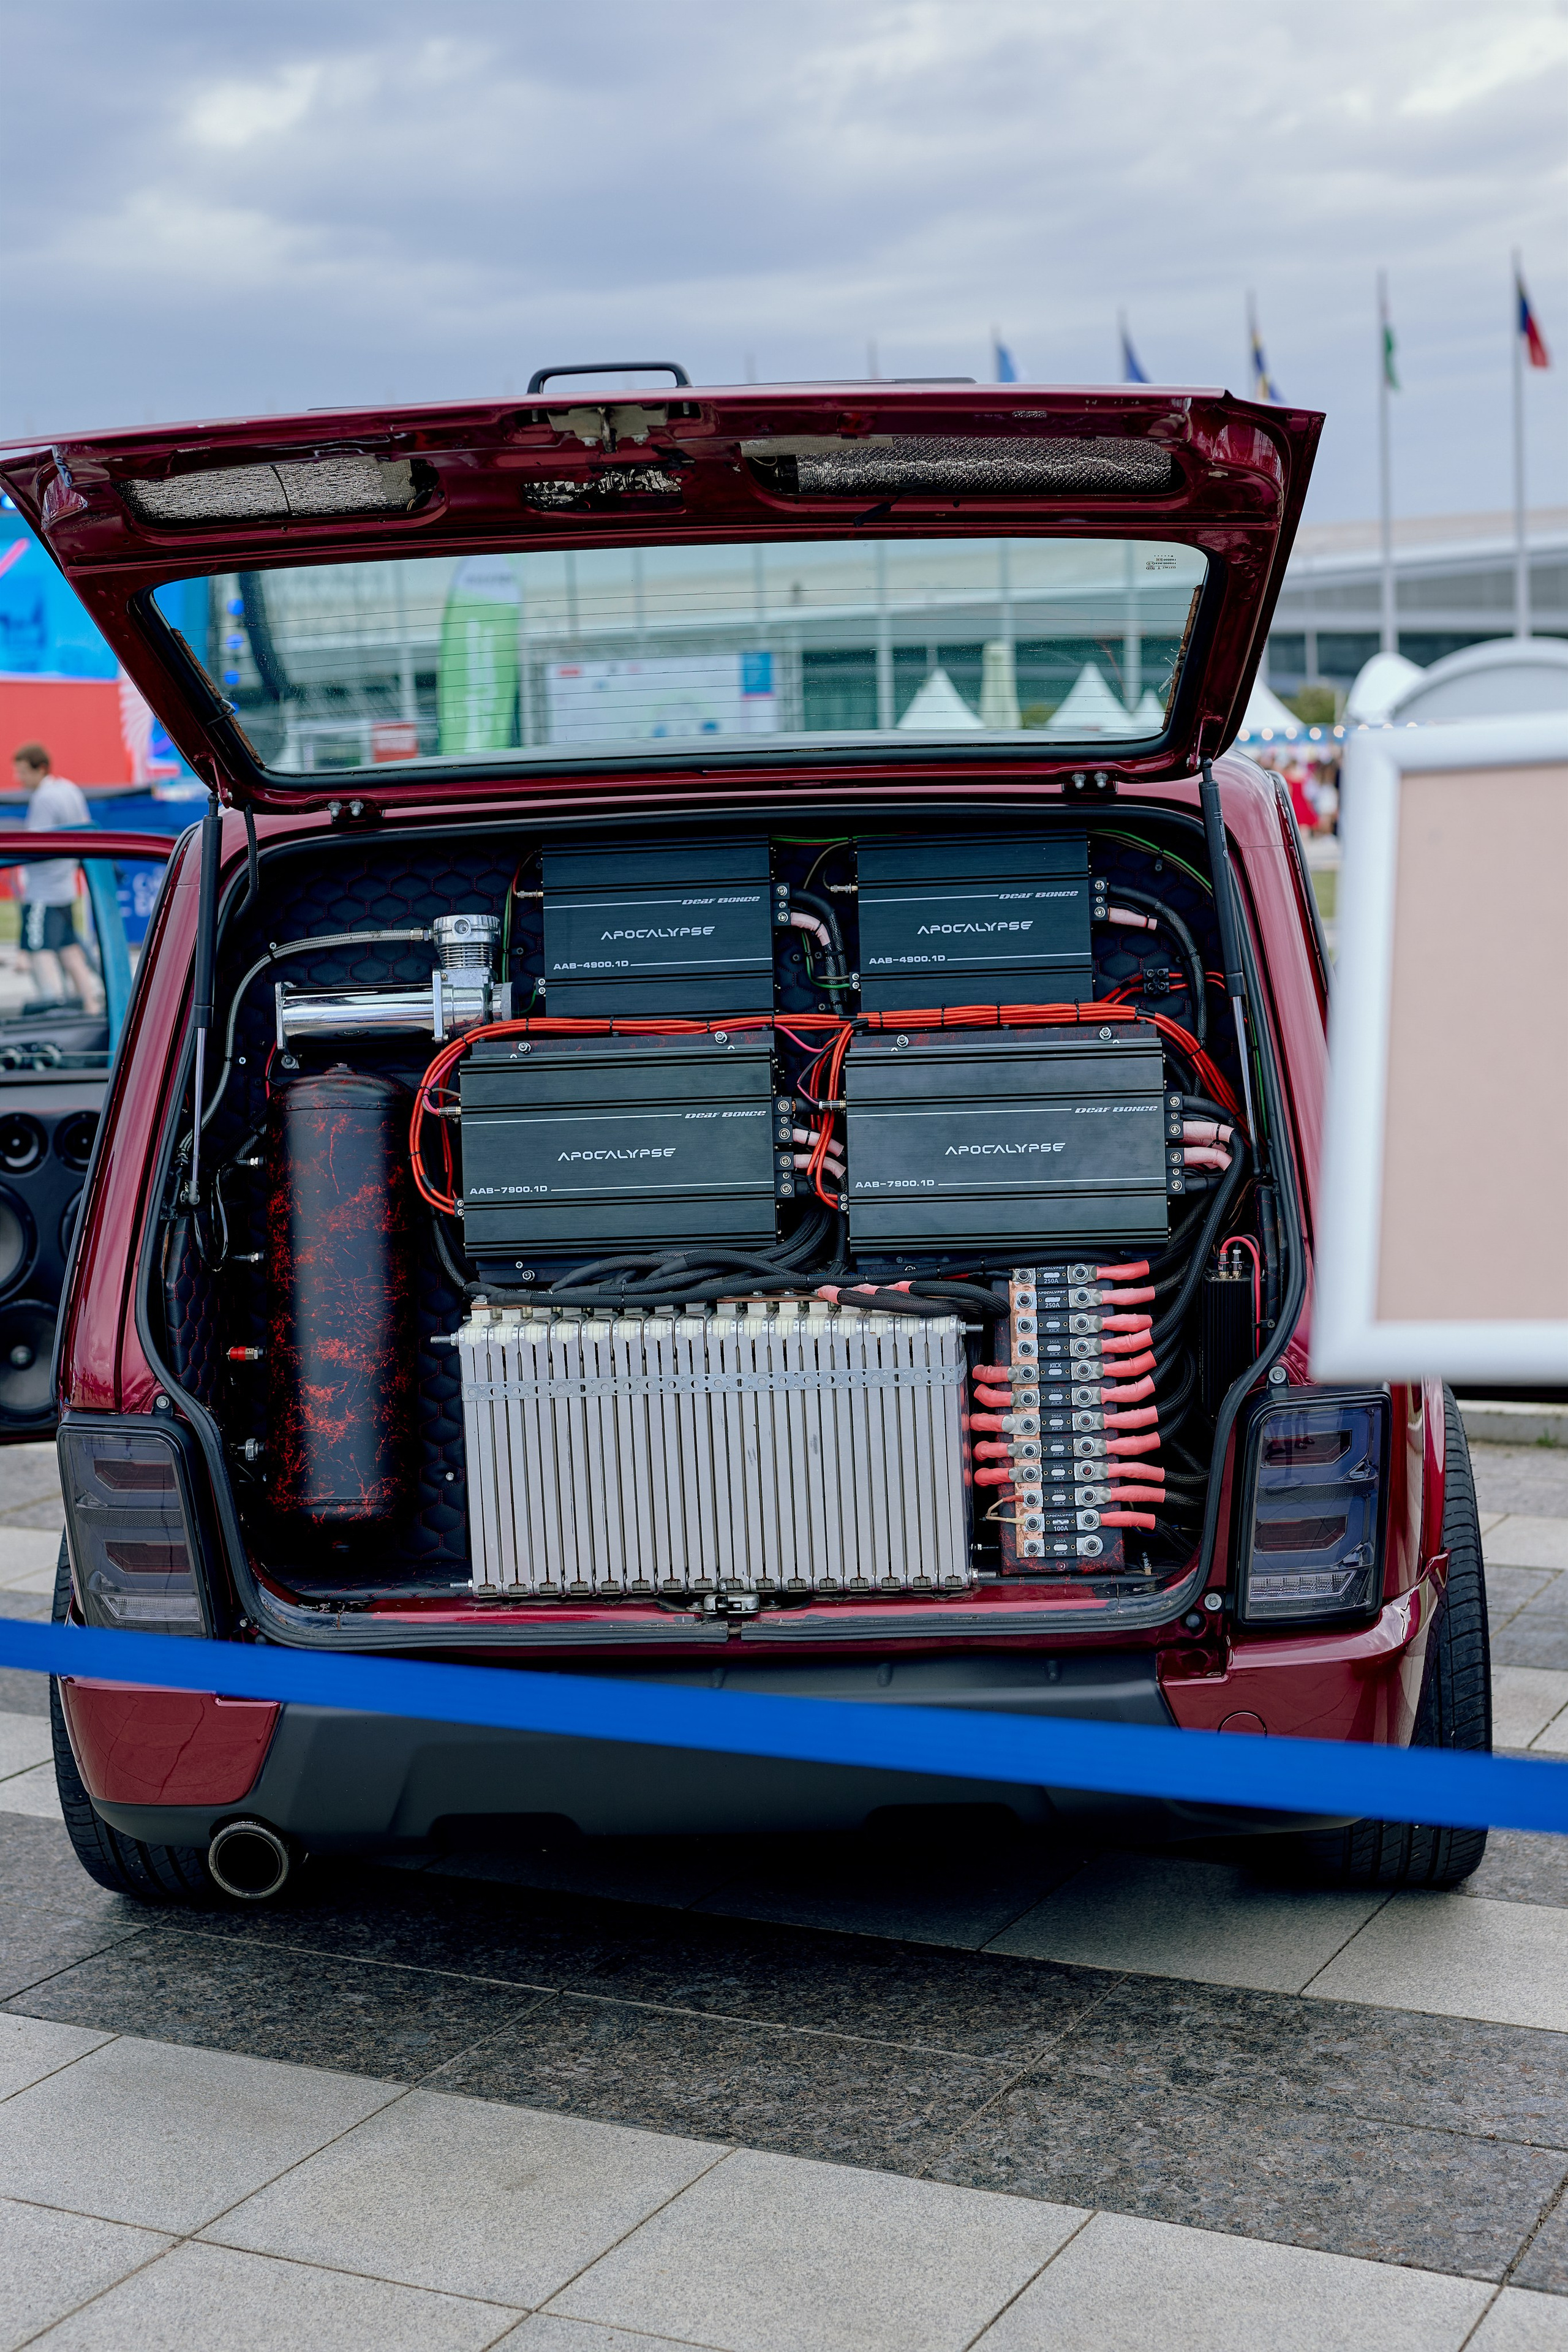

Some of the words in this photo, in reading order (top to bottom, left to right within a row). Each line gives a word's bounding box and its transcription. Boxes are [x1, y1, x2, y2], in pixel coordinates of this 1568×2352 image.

[600, 926, 715, 940] APOCALYPSE
[917, 921, 1033, 935] APOCALYPSE
[553, 960, 629, 970] AAB-4900.1D
[869, 954, 946, 965] AAB-4900.1D
[557, 1147, 676, 1161] APOCALYPSE
[944, 1142, 1066, 1155] APOCALYPSE
[854, 1179, 935, 1188] AAB-7900.1D
[469, 1185, 548, 1195] AAB-7900.1D
